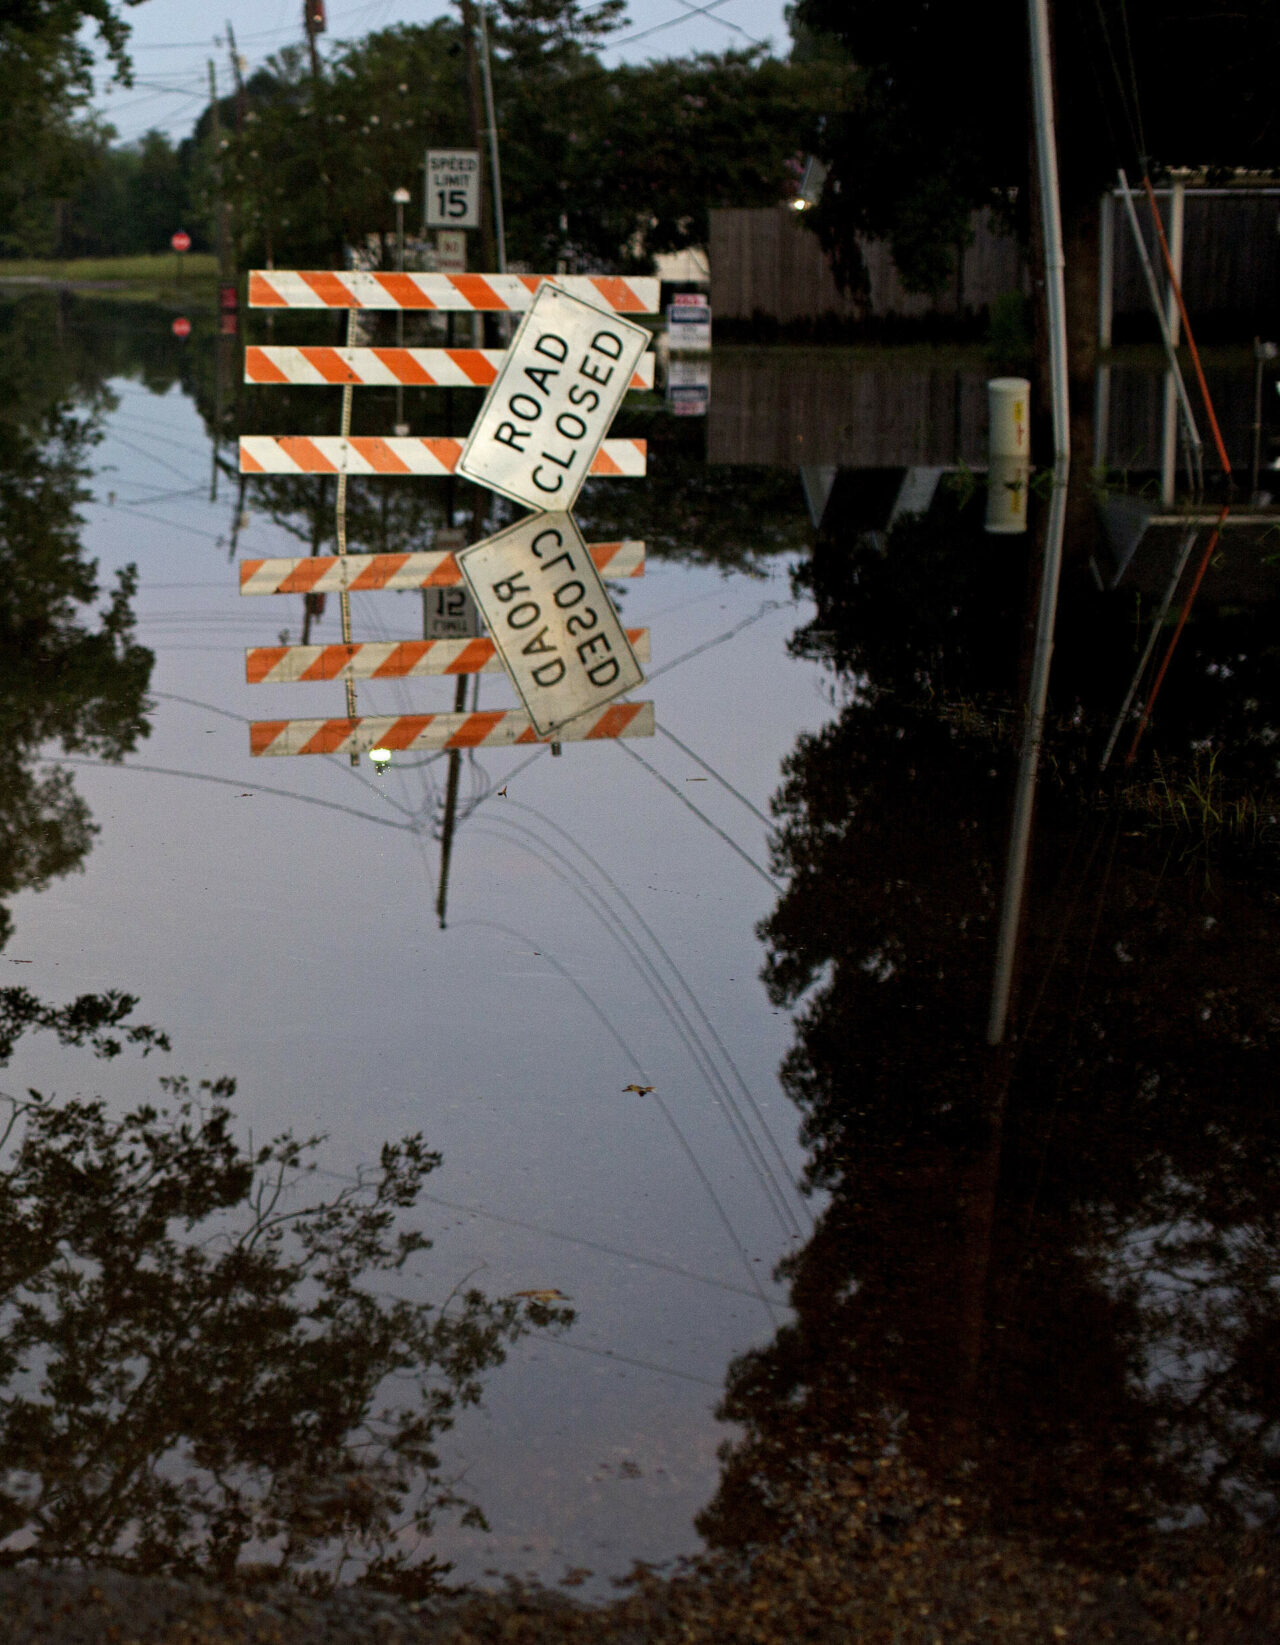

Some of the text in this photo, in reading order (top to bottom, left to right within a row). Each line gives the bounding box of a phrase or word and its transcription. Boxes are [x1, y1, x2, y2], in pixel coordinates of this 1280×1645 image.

[431, 158, 477, 171] SPEED
[435, 174, 470, 187] LIMIT
[437, 189, 468, 217] 15
[494, 332, 569, 453] ROAD
[532, 330, 624, 494] CLOSED
